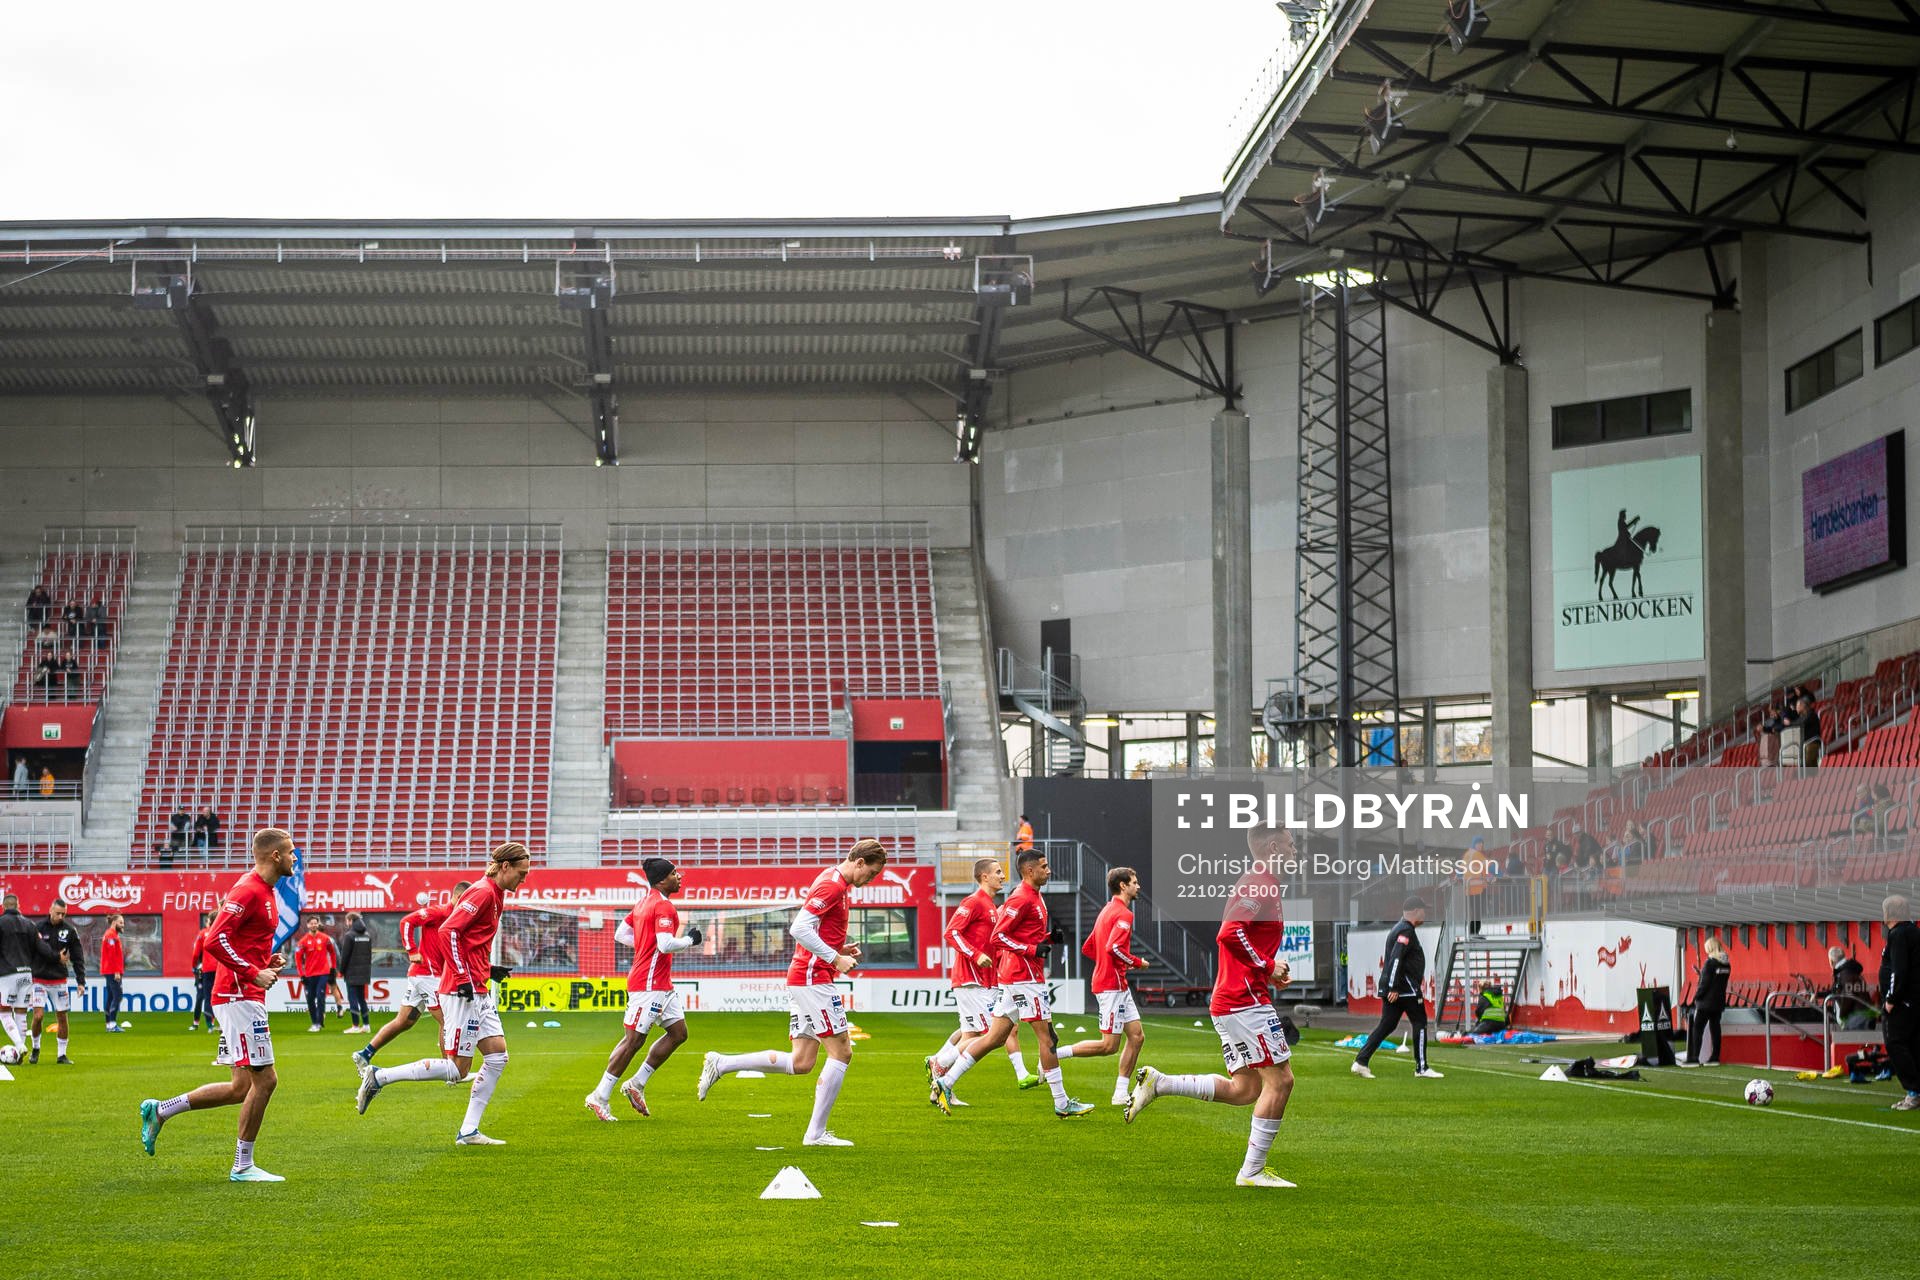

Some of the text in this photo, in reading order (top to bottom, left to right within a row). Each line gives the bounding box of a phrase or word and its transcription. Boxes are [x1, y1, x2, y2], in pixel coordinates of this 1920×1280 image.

[1811, 490, 1878, 541] Handelsbanken
[1562, 596, 1693, 627] STENBOCKEN
[59, 876, 142, 905] Carlsberg
[163, 892, 227, 911] FOREV
[569, 981, 630, 1009] Prin
